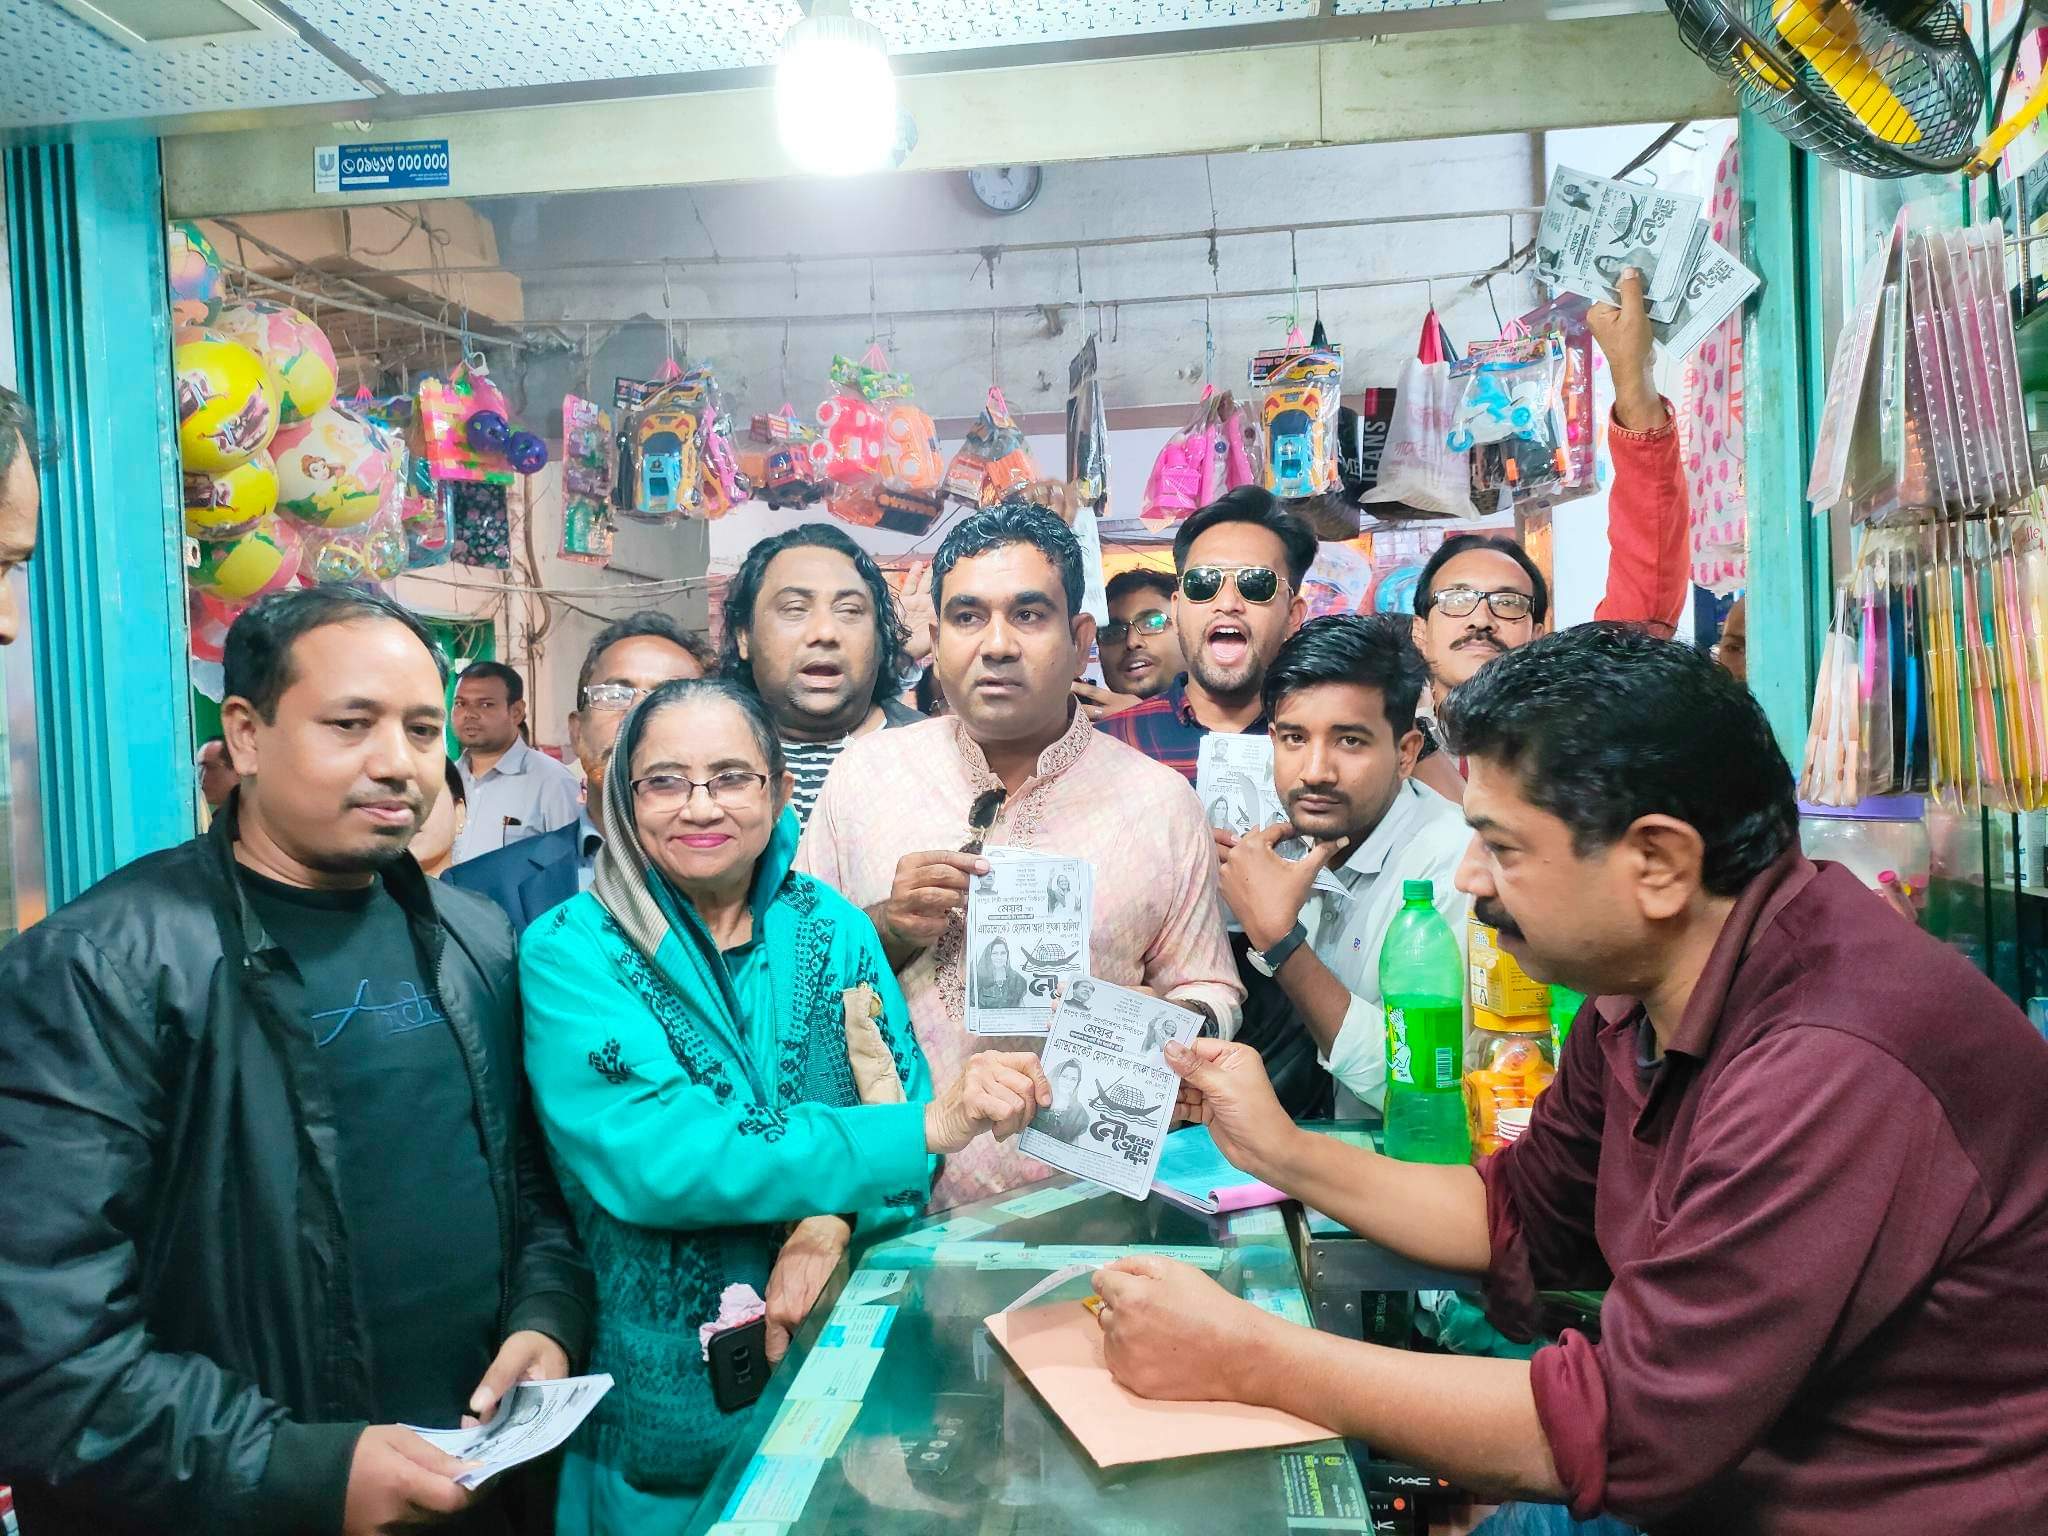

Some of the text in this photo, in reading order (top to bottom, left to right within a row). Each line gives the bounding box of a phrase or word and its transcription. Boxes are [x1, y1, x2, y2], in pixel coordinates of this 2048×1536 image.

[356, 152, 448, 174] ০৯৬১৩ ০০০ ০০০
[998, 904, 1023, 913] মেয়র
[1084, 1024, 1114, 1039] মেয়র
[1388, 1476, 1431, 1486] MAC
